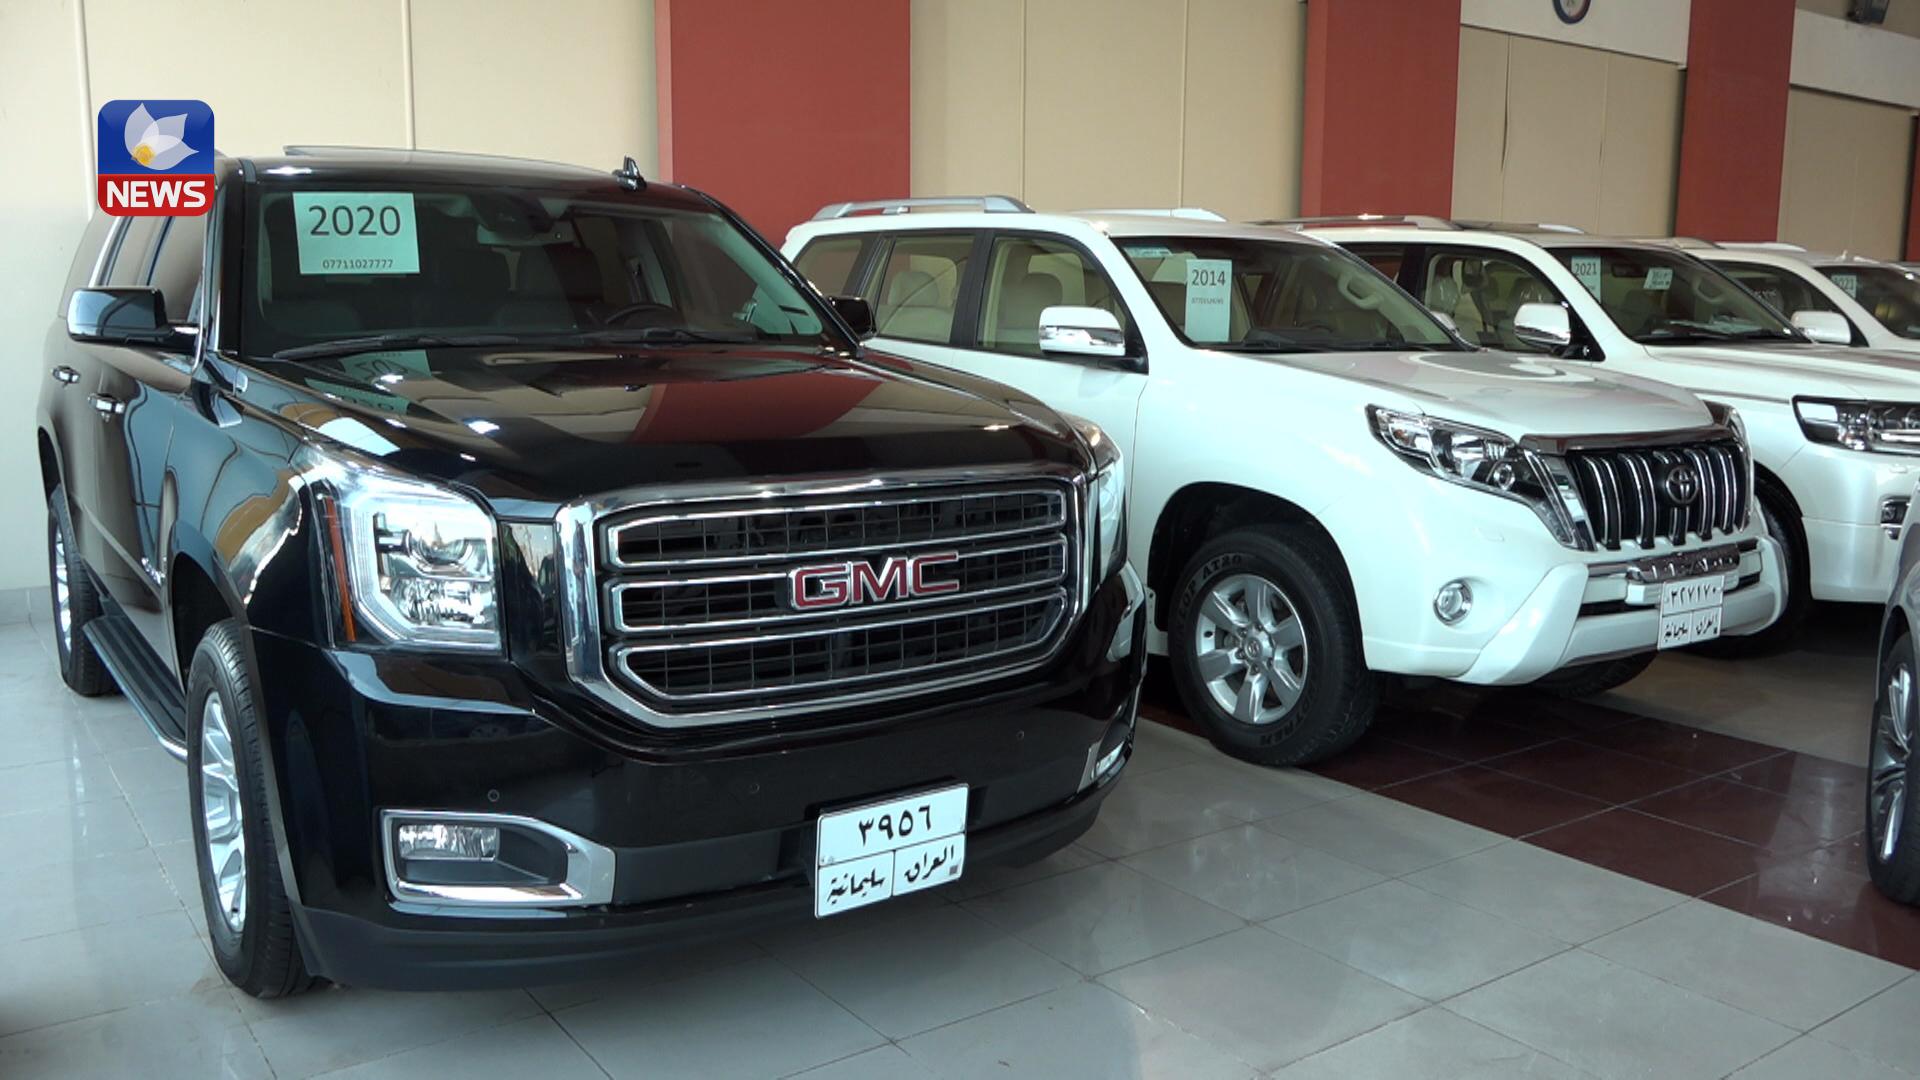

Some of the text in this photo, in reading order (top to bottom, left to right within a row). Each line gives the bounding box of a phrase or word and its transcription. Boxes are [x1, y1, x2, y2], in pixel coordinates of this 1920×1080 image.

[308, 205, 401, 236] 2020
[322, 258, 394, 269] 07711027777
[1191, 269, 1226, 287] 2014
[1575, 262, 1597, 276] 2021
[788, 551, 960, 610] GMC
[858, 804, 932, 847] ٣٩٥٦
[903, 844, 955, 883] العراق
